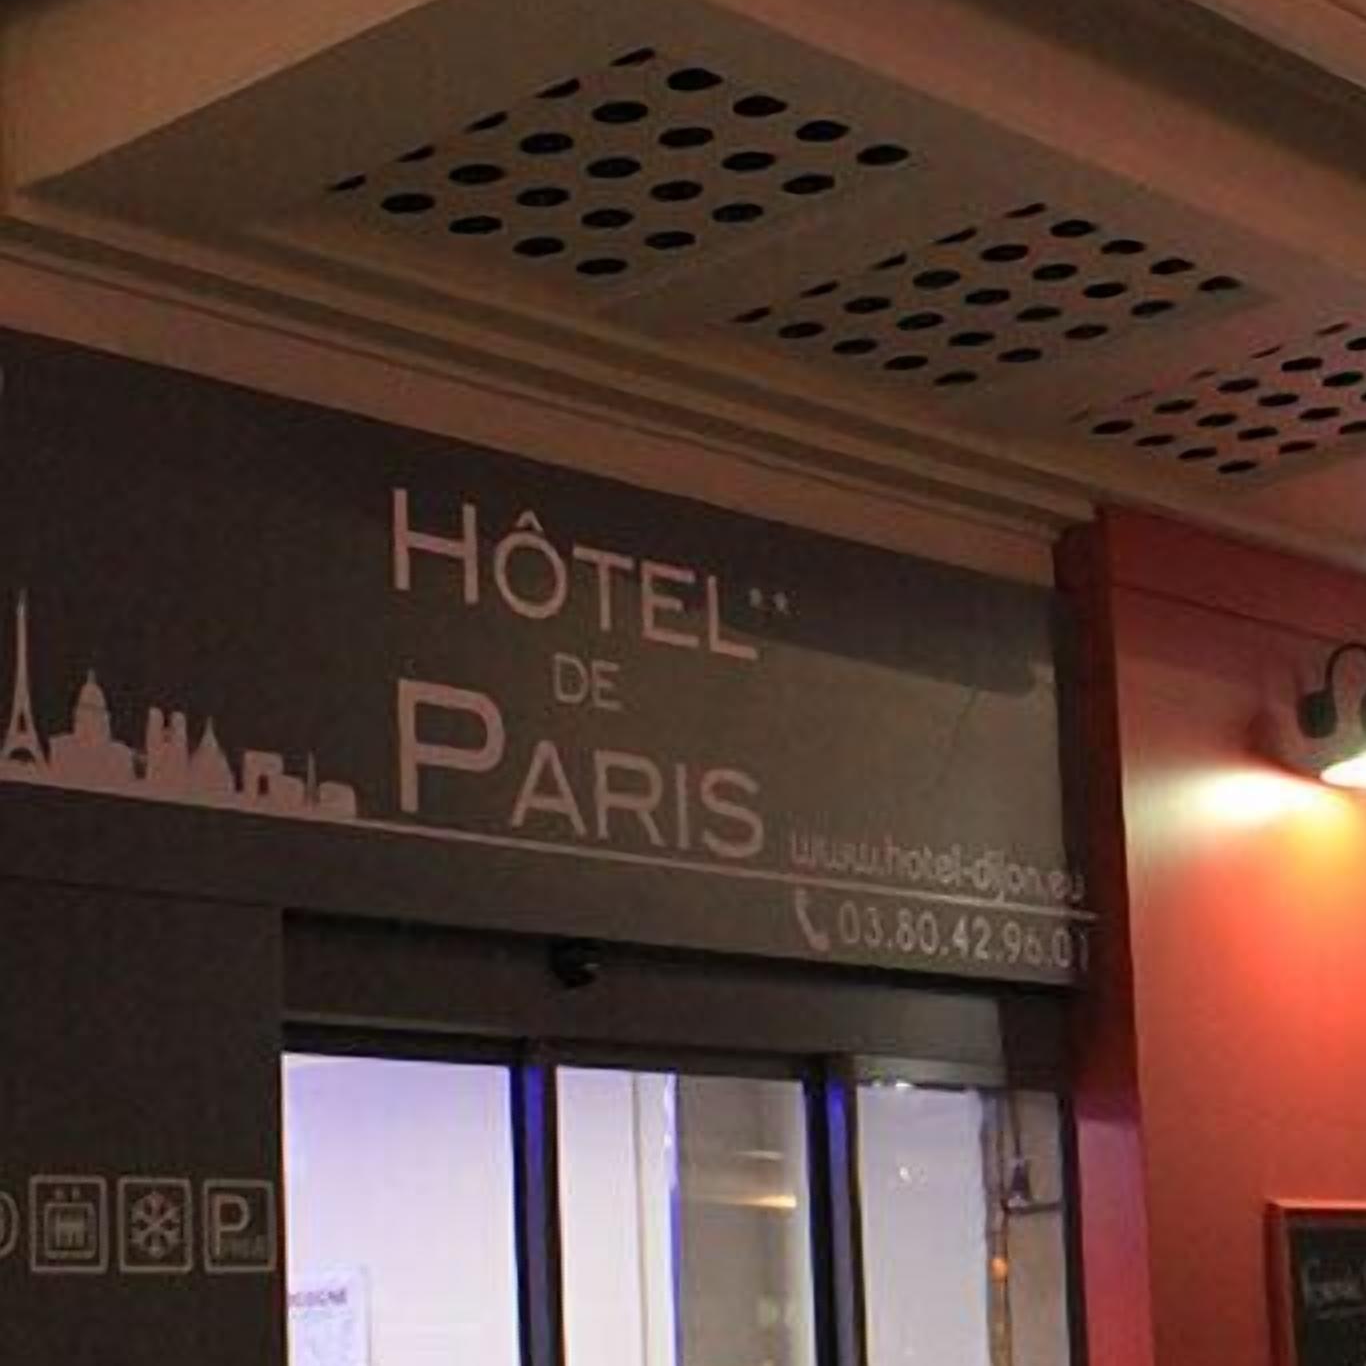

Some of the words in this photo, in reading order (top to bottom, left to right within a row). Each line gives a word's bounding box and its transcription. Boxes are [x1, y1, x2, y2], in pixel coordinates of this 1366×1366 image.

[391, 486, 760, 662] HÔTEL
[396, 677, 766, 860] PARIS
[552, 649, 623, 713] DE
